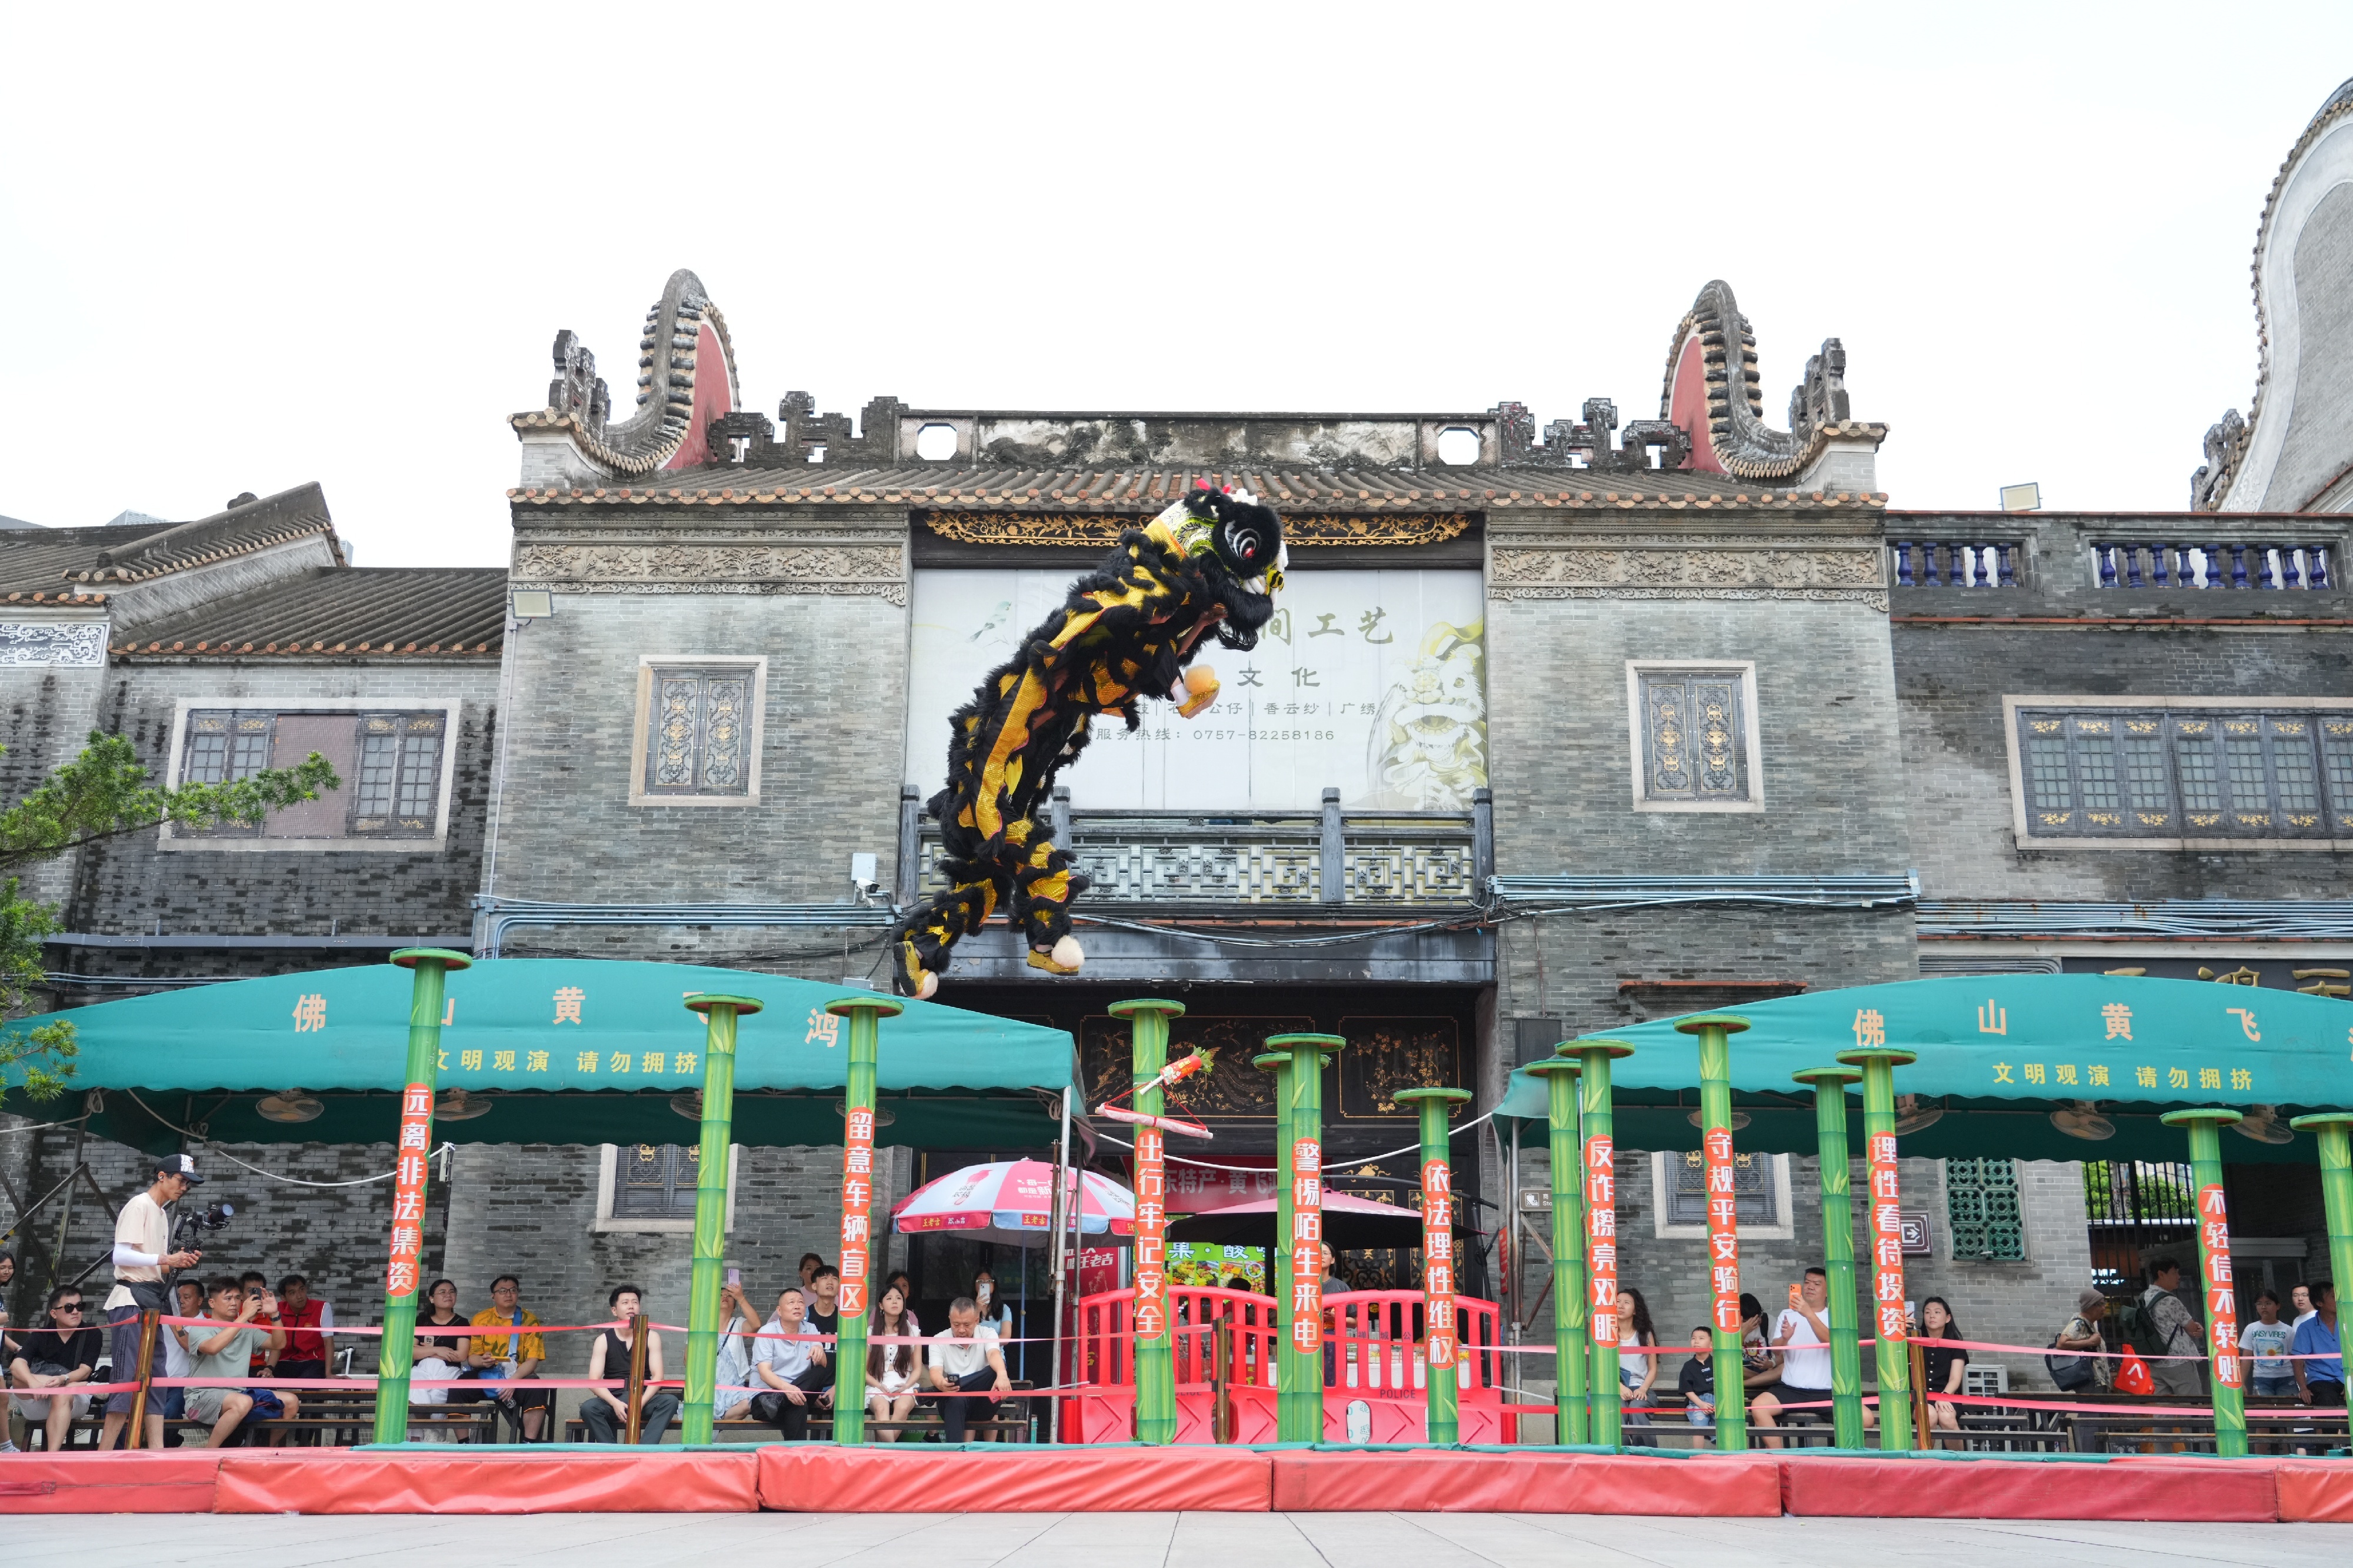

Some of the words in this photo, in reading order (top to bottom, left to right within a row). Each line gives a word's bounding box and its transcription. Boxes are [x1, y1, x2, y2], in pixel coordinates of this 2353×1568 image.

[1194, 730, 1334, 740] 0757-82258186
[1264, 703, 1319, 715] 香云纱
[1341, 703, 1376, 715] 广绣
[576, 1050, 698, 1074] 请勿拥挤
[1992, 1062, 2110, 1087] 文明观演
[2135, 1066, 2252, 1091] 请勿拥挤
[388, 1089, 429, 1291] 远离非法集资
[839, 1112, 872, 1312] 留意车辆盲区
[1024, 1215, 1046, 1225] 王老吉
[1137, 1134, 1164, 1334] 出行牢记安全
[1294, 1142, 1320, 1349] 警惕陌生来电
[1424, 1164, 1455, 1365] 依法理性维权
[1589, 1140, 1619, 1342] 反诈擦亮双眼
[1707, 1132, 1740, 1328] 守规平安骑行
[1872, 1136, 1906, 1337] 理性看待投资
[2202, 1189, 2242, 1383] 不轻信不转账
[1380, 1389, 1416, 1399] POLICE
[2268, 1331, 2286, 1339] VIBES
